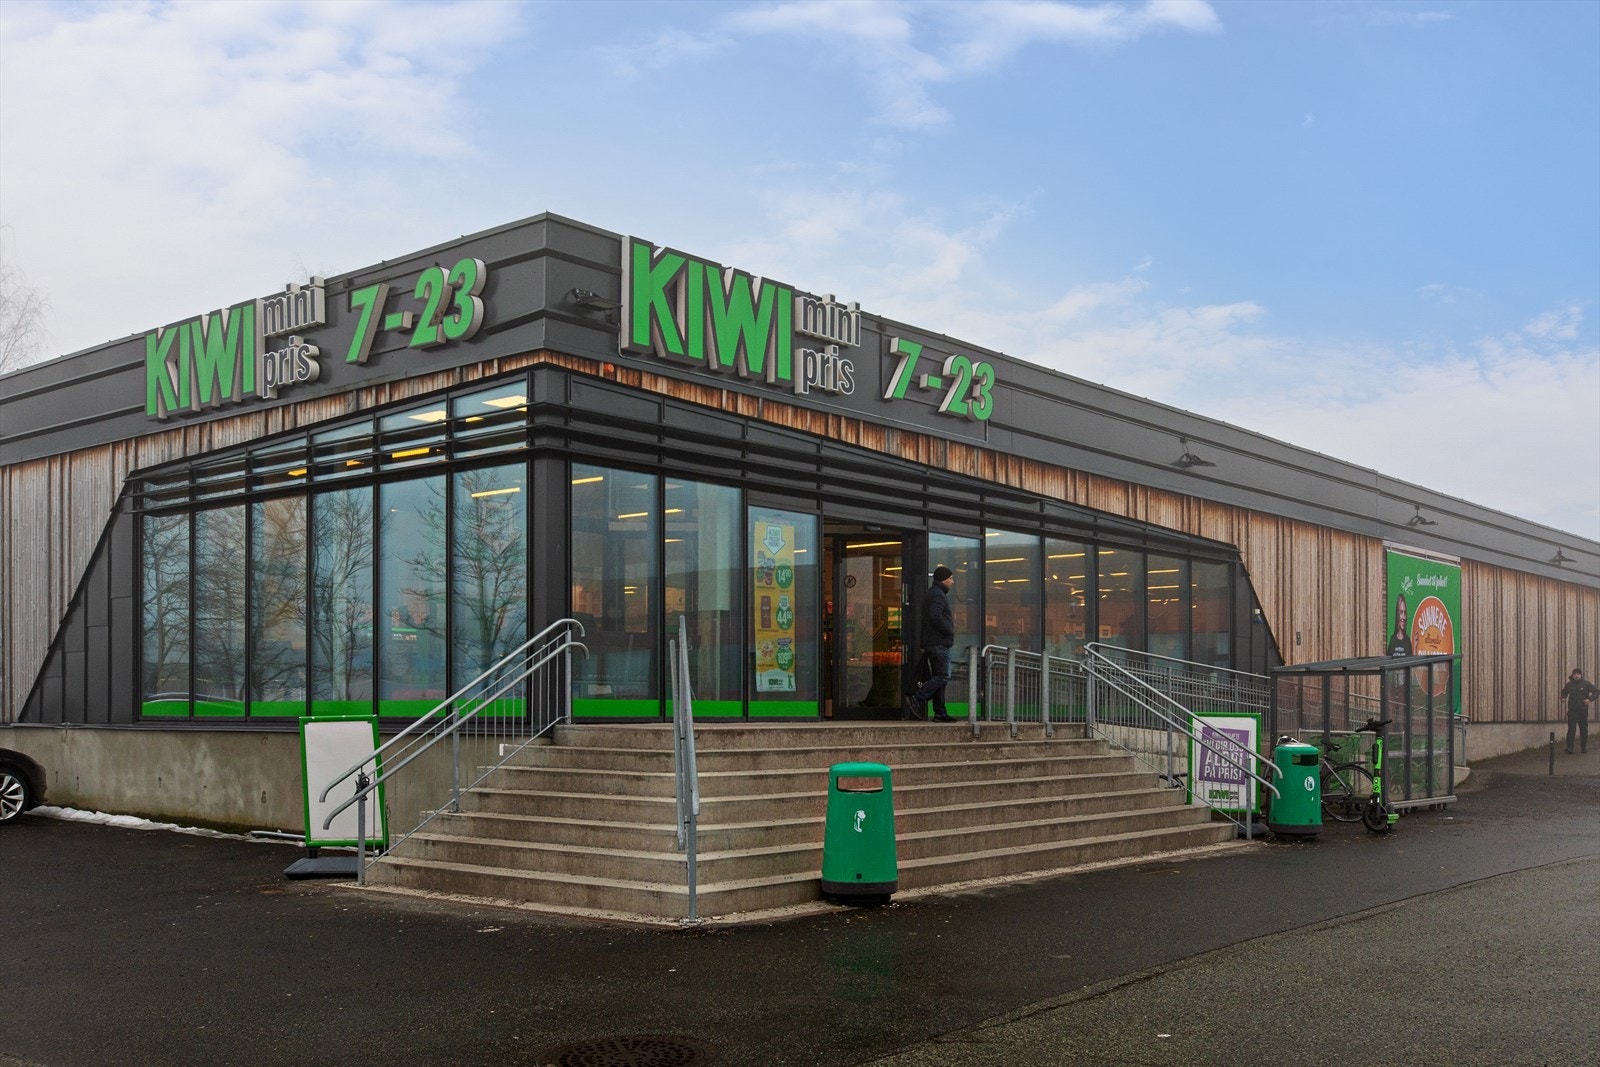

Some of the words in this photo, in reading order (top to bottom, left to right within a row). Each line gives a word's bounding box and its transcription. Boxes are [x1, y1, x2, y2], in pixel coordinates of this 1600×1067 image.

[262, 277, 325, 336] mini
[345, 258, 483, 364] 7-23
[631, 240, 794, 384] KIWI
[798, 294, 861, 347] mini
[145, 303, 256, 416] KIWI
[262, 336, 319, 398] pris
[798, 346, 855, 394] pris
[885, 338, 995, 420] 7-23
[1218, 767, 1242, 780] PRIS!
